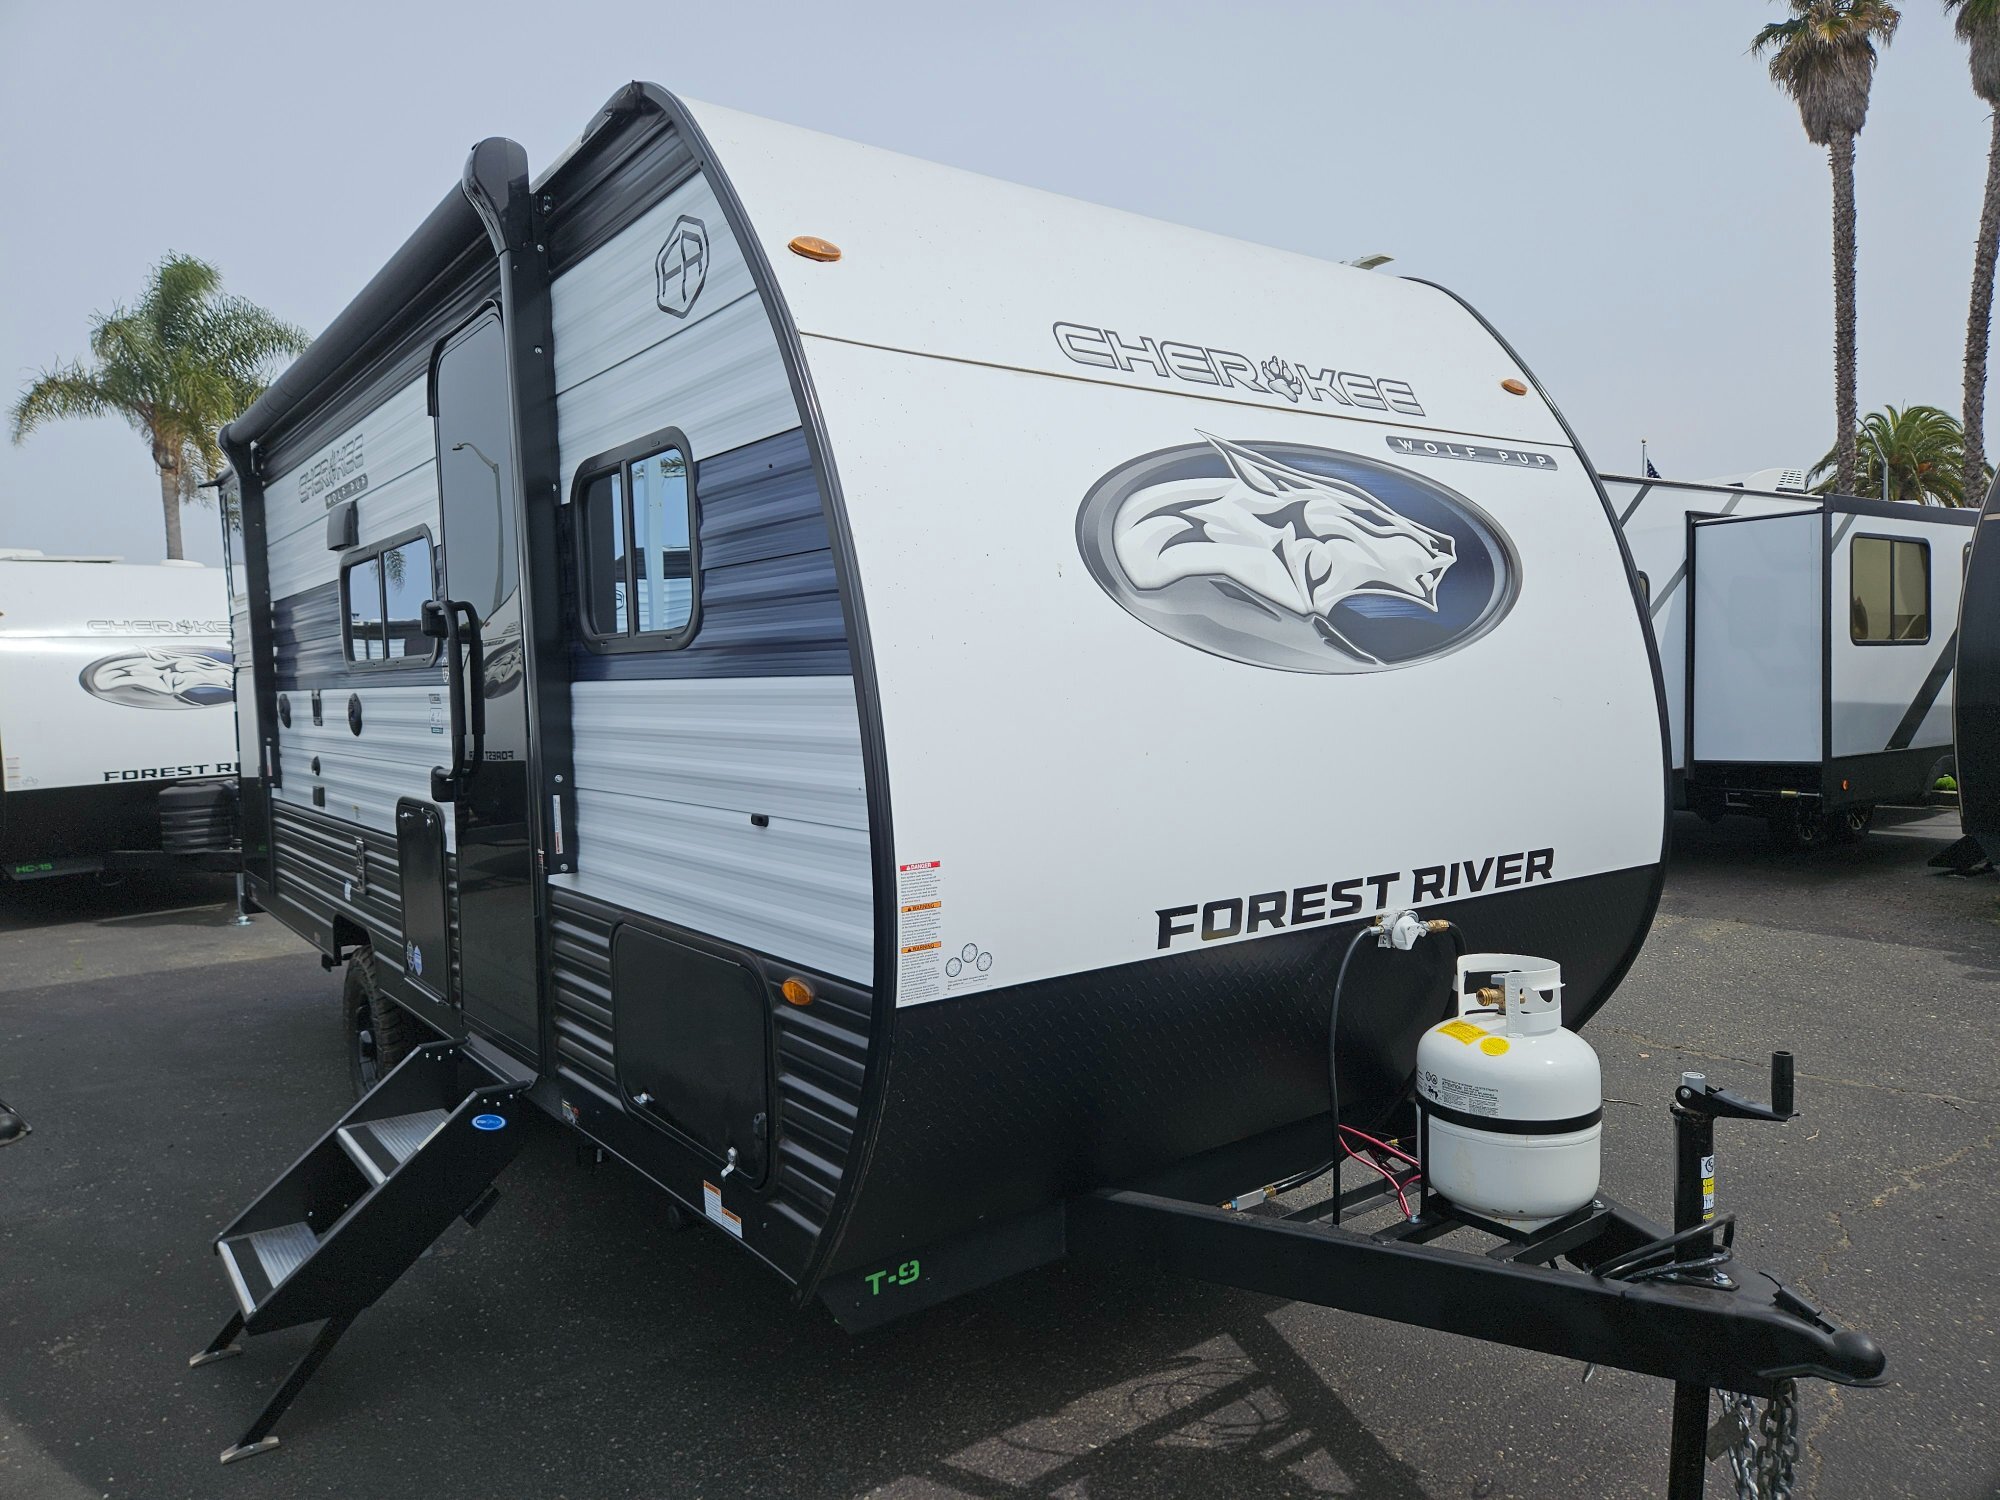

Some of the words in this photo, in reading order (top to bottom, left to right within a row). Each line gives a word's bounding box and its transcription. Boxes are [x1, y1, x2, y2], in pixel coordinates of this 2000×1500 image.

[1052, 321, 1426, 417] CHEROKEE
[1397, 438, 1476, 458] WOLF
[1498, 450, 1547, 466] PUP
[86, 619, 232, 635] CHEROKE
[103, 764, 209, 782] FOREST
[910, 862, 932, 870] DANGER
[912, 902, 935, 911] WARNING
[1155, 872, 1401, 950] FOREST
[1412, 847, 1555, 903] RIVER
[912, 943, 935, 951] WARNING
[865, 1260, 920, 1296] T-9
